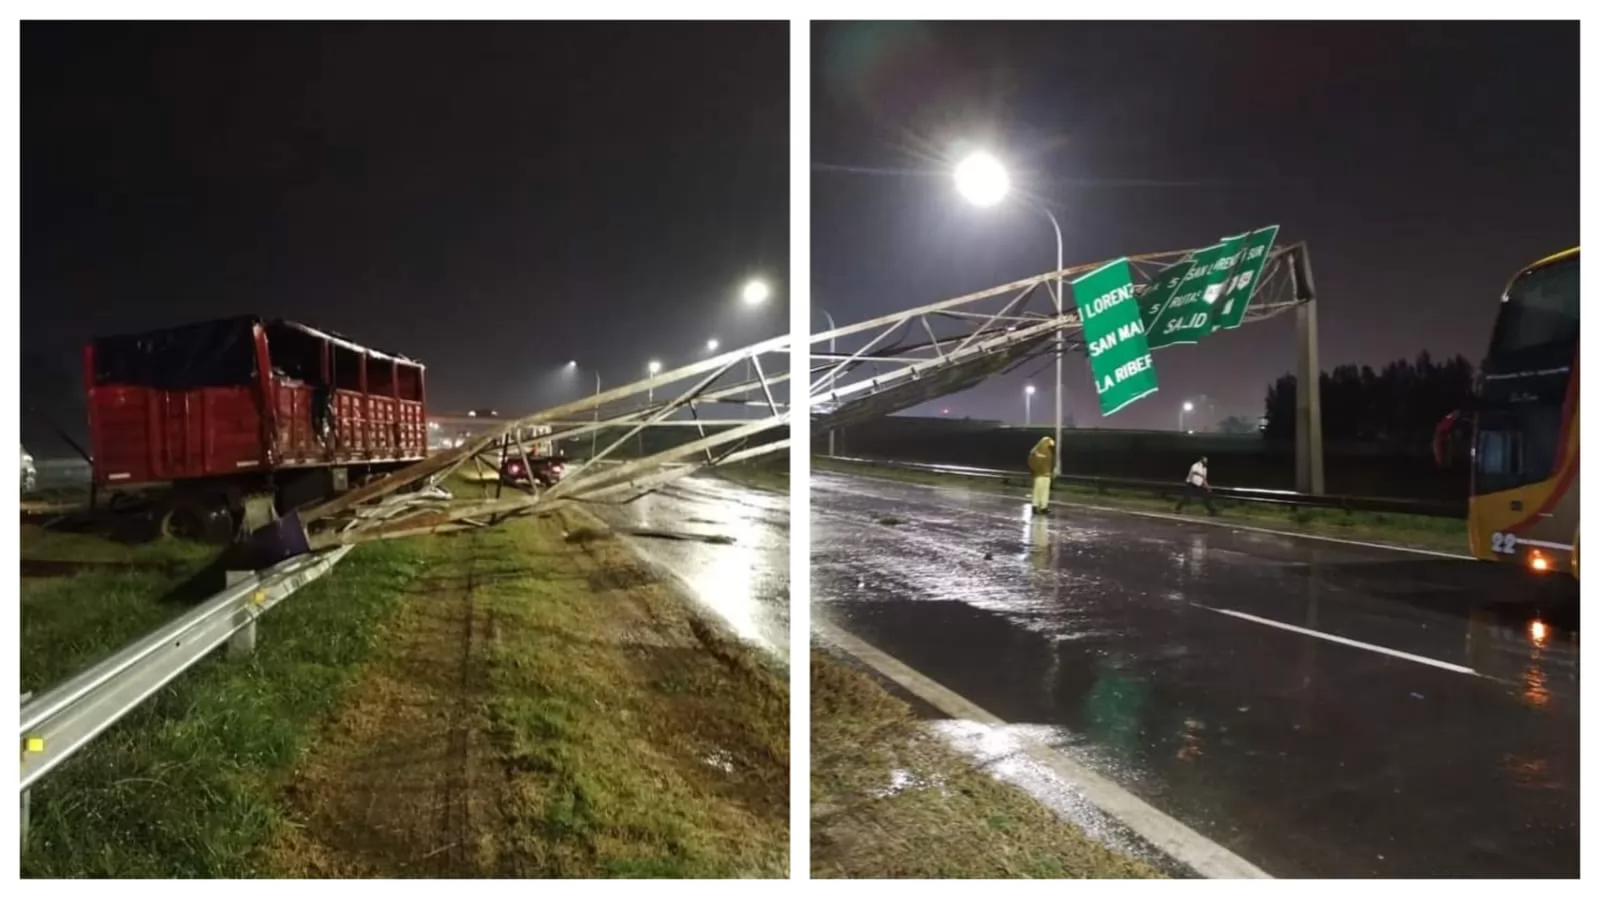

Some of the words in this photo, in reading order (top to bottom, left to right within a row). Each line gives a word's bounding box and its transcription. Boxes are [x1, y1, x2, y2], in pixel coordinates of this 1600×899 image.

[1088, 330, 1118, 358] SAN
[1095, 373, 1116, 395] LA
[1491, 531, 1517, 555] 22
